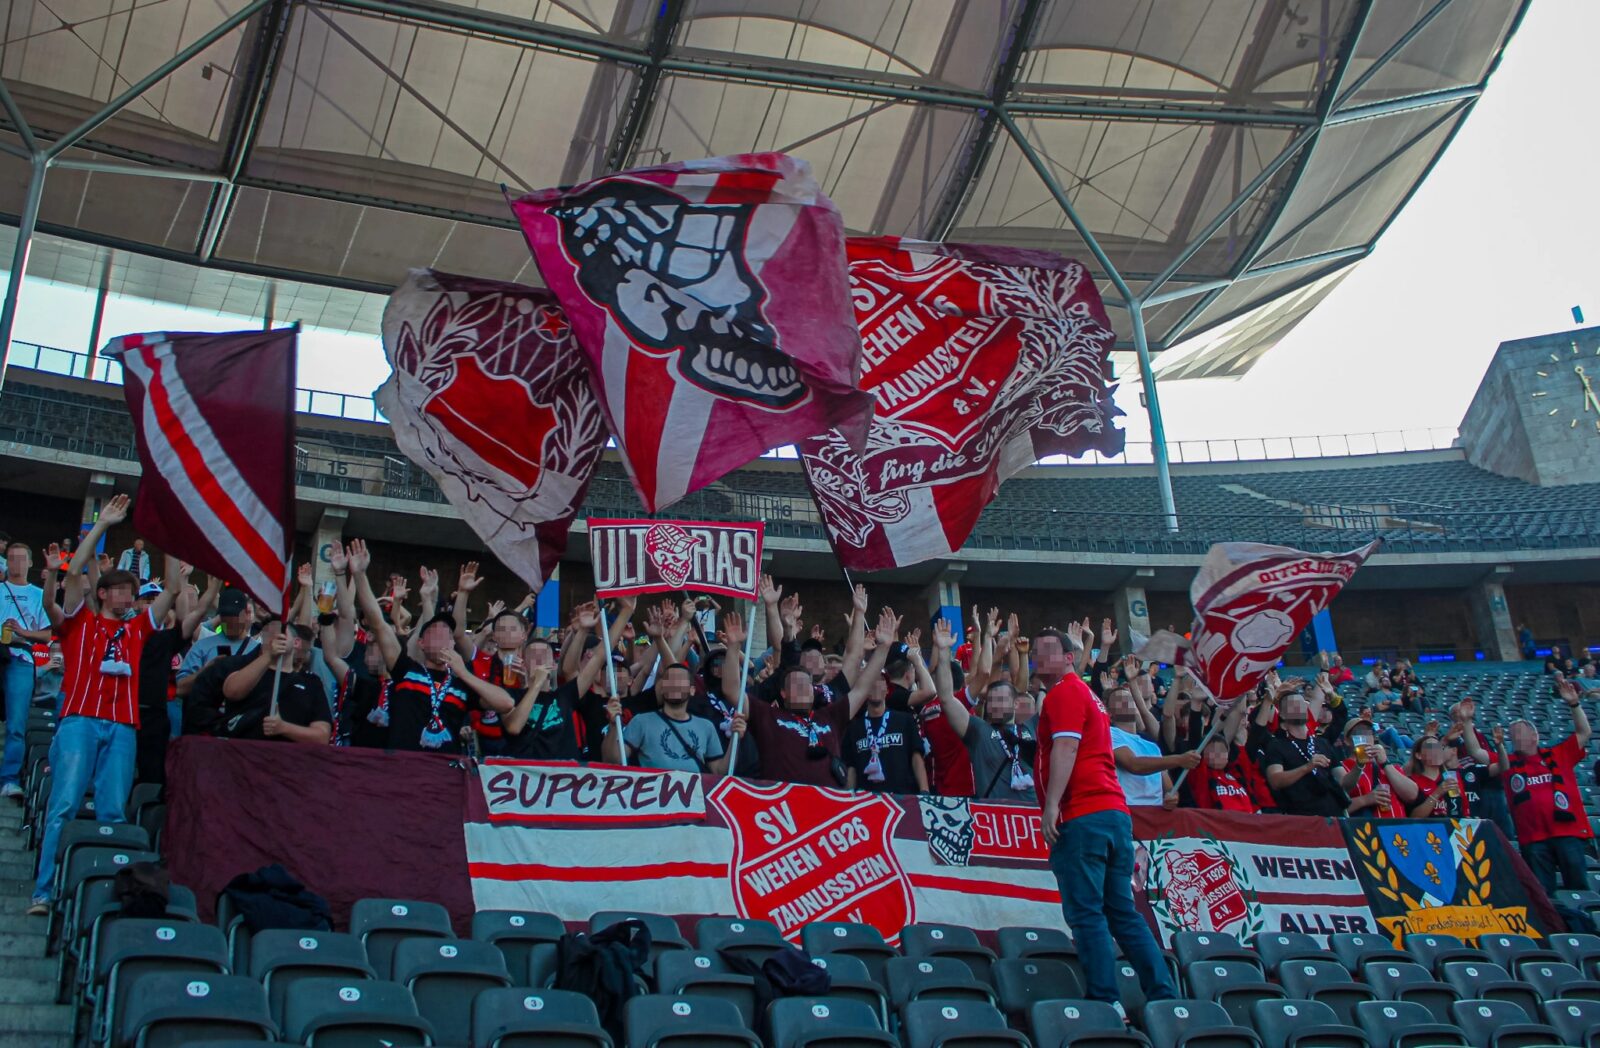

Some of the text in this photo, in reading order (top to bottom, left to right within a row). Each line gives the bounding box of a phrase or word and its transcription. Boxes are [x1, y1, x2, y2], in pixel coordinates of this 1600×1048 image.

[327, 461, 348, 476] 15
[811, 466, 858, 498] 1926
[930, 451, 967, 474] die
[774, 503, 792, 517] 16
[1131, 600, 1147, 617] G
[487, 771, 699, 810] SUPCREW
[755, 801, 798, 845] SV
[743, 817, 870, 897] WEHEN 1926
[1251, 853, 1357, 881] WEHEN
[1206, 865, 1227, 883] 1926
[768, 853, 890, 932] TAUNUSSTEIN
[1214, 904, 1232, 920] e.V.
[1280, 912, 1370, 936] ALLER
